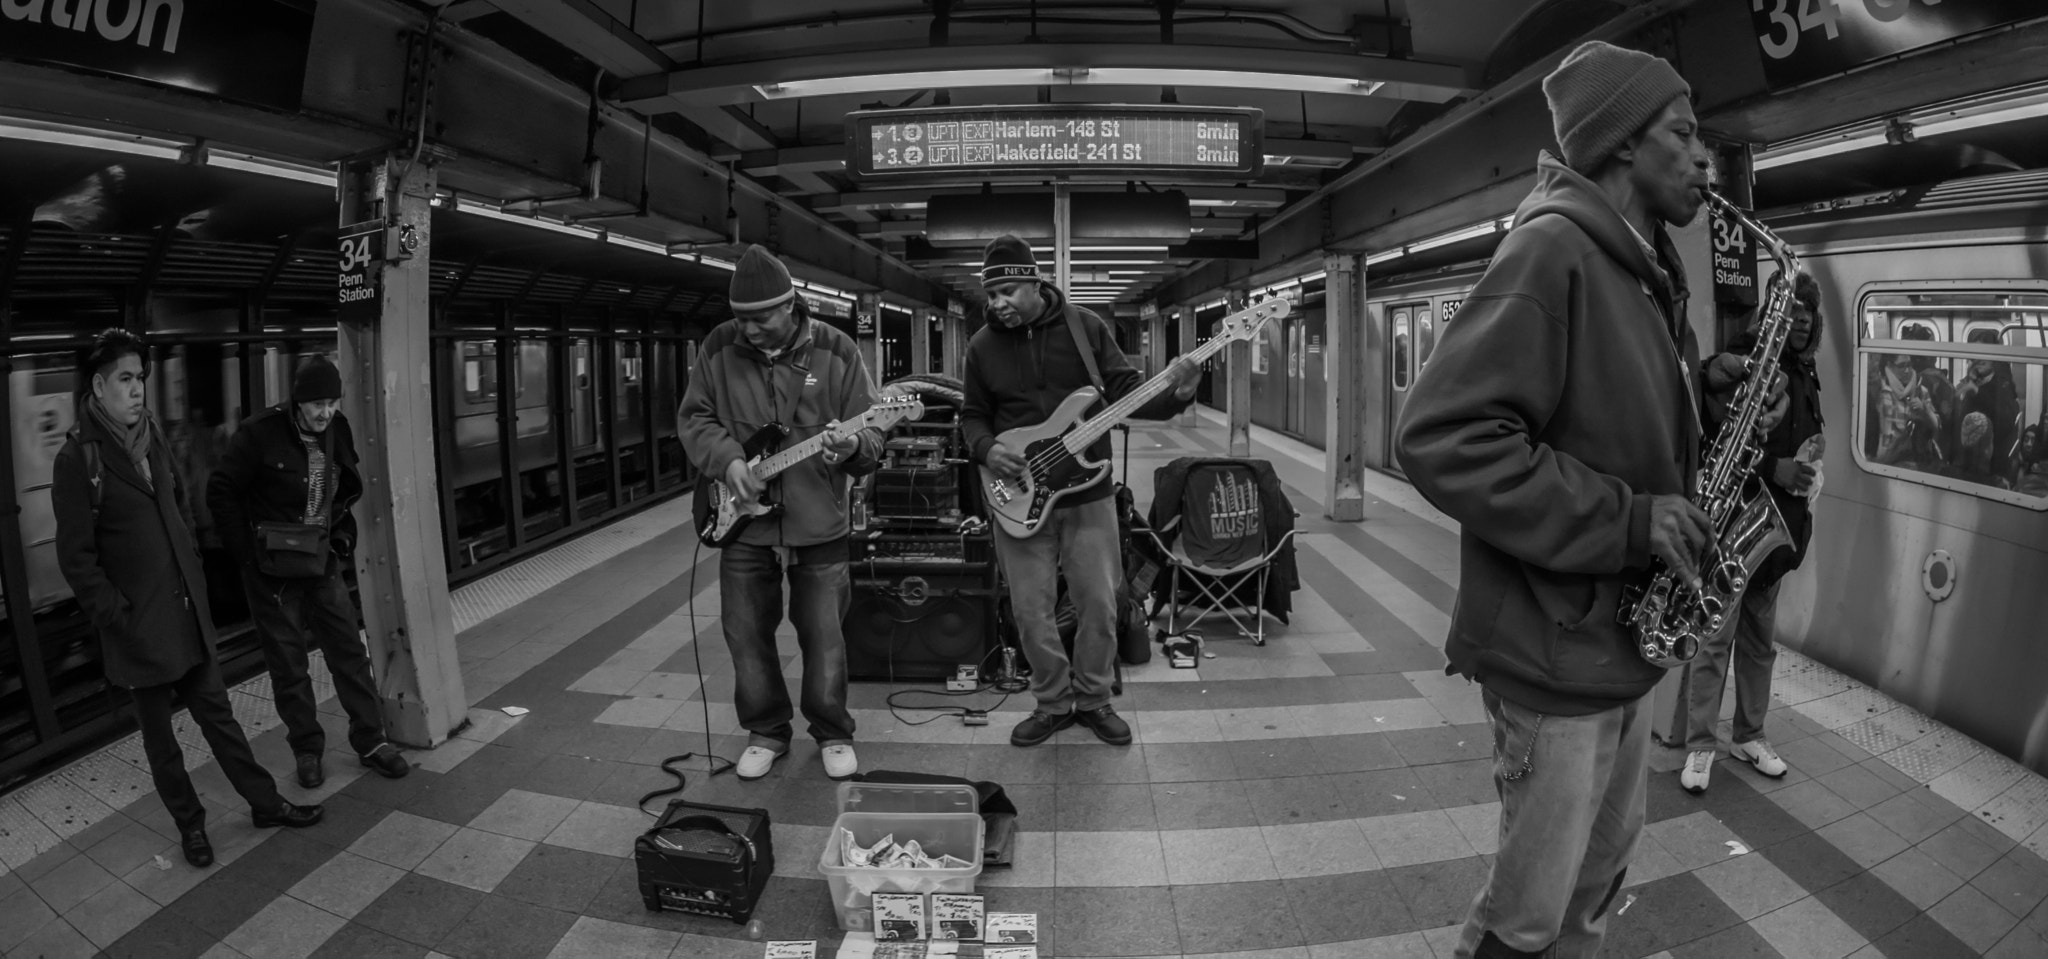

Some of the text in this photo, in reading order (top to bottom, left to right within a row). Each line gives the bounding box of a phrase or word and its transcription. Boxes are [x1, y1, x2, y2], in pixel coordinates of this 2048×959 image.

[1753, 0, 1841, 60] 34
[930, 123, 957, 141] UPT
[963, 122, 992, 140] EXP
[995, 120, 1096, 139] Harlem-148
[1100, 120, 1121, 138] St
[1196, 122, 1239, 141] 6min
[930, 147, 957, 163] UPT
[964, 145, 993, 162] EXP
[1122, 143, 1142, 161] St
[1196, 144, 1239, 163] 8min
[1713, 218, 1747, 255] 34
[339, 235, 372, 272] 34
[1714, 252, 1740, 270] Penn
[338, 273, 363, 288] Penn
[1715, 268, 1752, 287] Station
[338, 286, 375, 303] Station
[857, 315, 873, 325] 34
[1210, 513, 1259, 534] MUSIC
